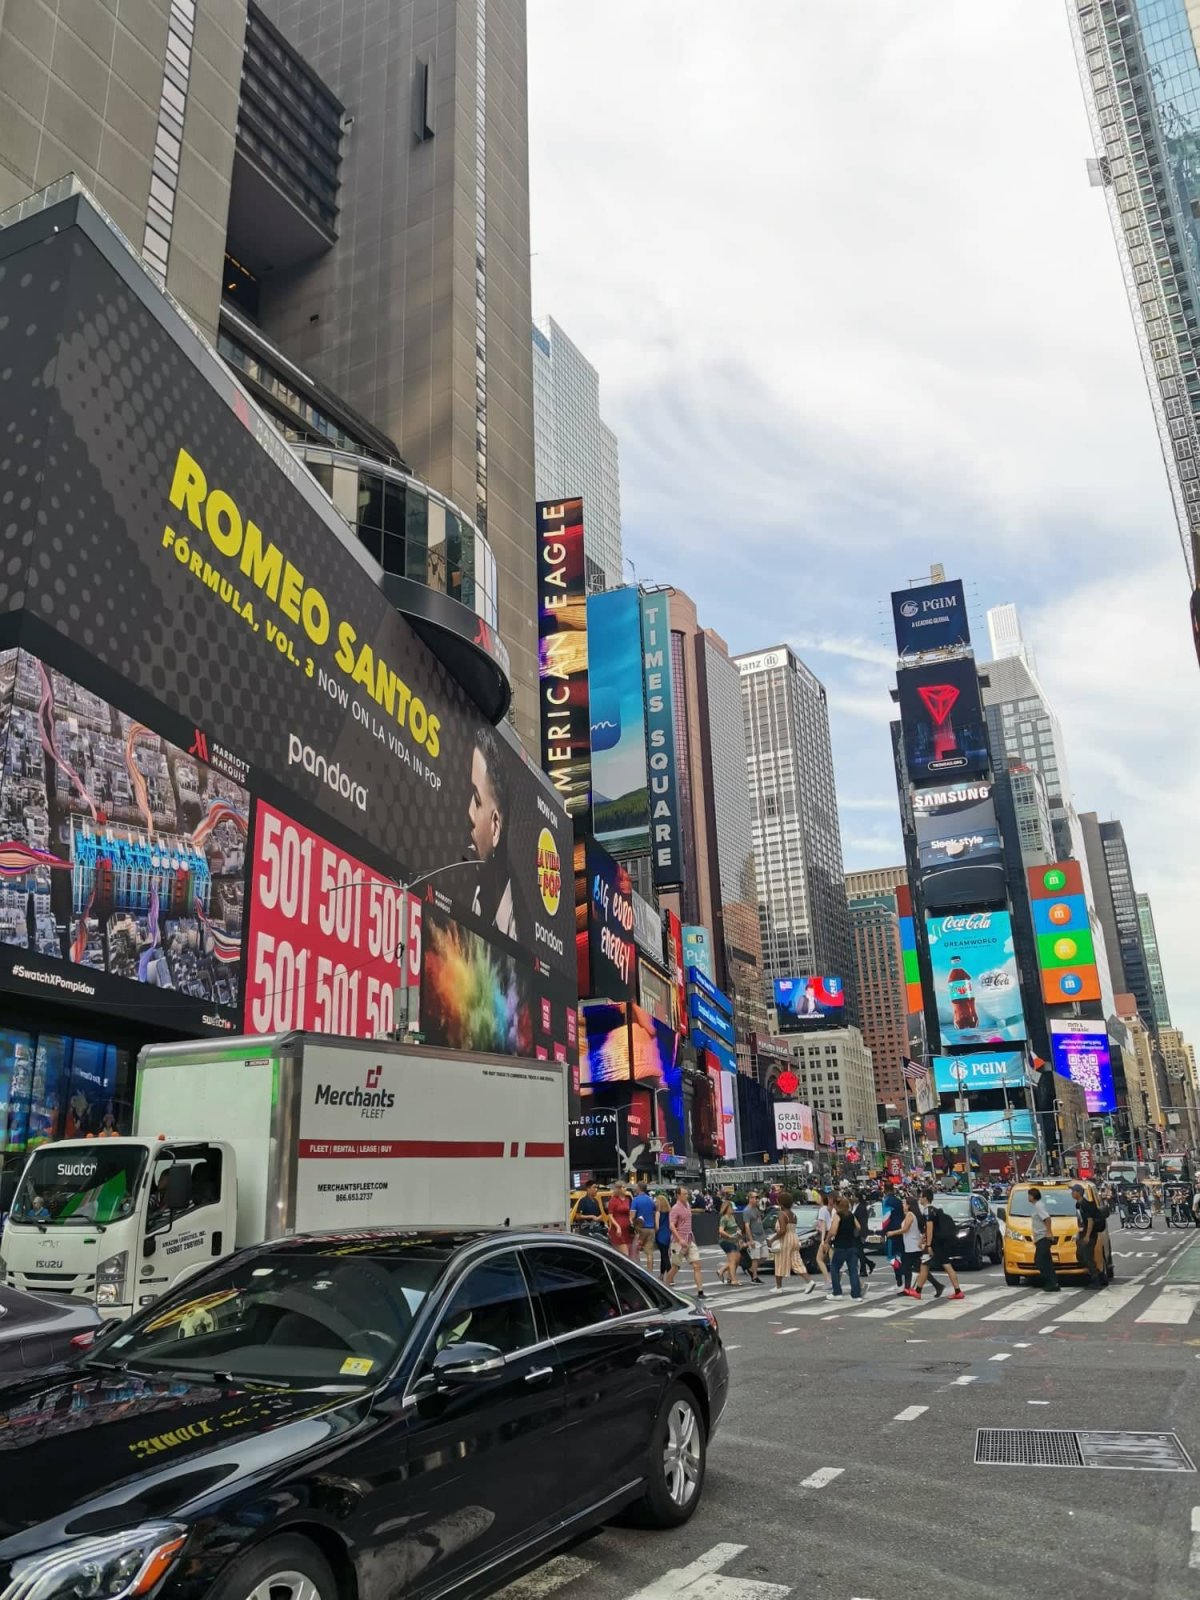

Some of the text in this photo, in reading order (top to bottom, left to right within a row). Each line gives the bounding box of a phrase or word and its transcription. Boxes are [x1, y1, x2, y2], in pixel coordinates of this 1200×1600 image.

[543, 505, 567, 609] EAGLE
[169, 448, 441, 758] ROMEO SANTOS
[922, 595, 957, 612] PGIM
[162, 525, 441, 791] FÓRMULA, VOL. 3 NOW ON LA VIDA IN POP
[644, 607, 673, 867] TIMES SQUARE
[211, 756, 246, 784] MARQUIS
[212, 743, 250, 774] MARRIOTT
[288, 732, 367, 812] pandora
[913, 786, 989, 807] SAMSUNG
[537, 795, 559, 829] NOW ON
[958, 836, 984, 847] style
[259, 812, 312, 926] 501
[319, 848, 364, 949] 501
[543, 873, 562, 898] POP
[593, 874, 609, 922] BIG
[942, 912, 992, 933] Coca-Cola
[535, 921, 564, 955] pandora
[944, 938, 997, 948] DREAMWORLD
[601, 926, 631, 985] ENERGY
[12, 964, 95, 995] #SwatchXPompidou
[252, 931, 395, 1039] 501 501 50
[202, 1014, 228, 1030] swatch
[972, 1061, 1007, 1076] PGIM
[315, 1084, 395, 1108] Merchants
[361, 1108, 386, 1119] FLEET
[575, 1126, 606, 1137] EAGLE
[309, 1144, 393, 1153] FLEET RENTAL LEASE BUY
[317, 1182, 389, 1192] MERCHANTSFLEET.COM
[162, 1239, 179, 1248] AMAZON
[166, 1244, 183, 1255] USDOT
[35, 1260, 63, 1269] ISUZU
